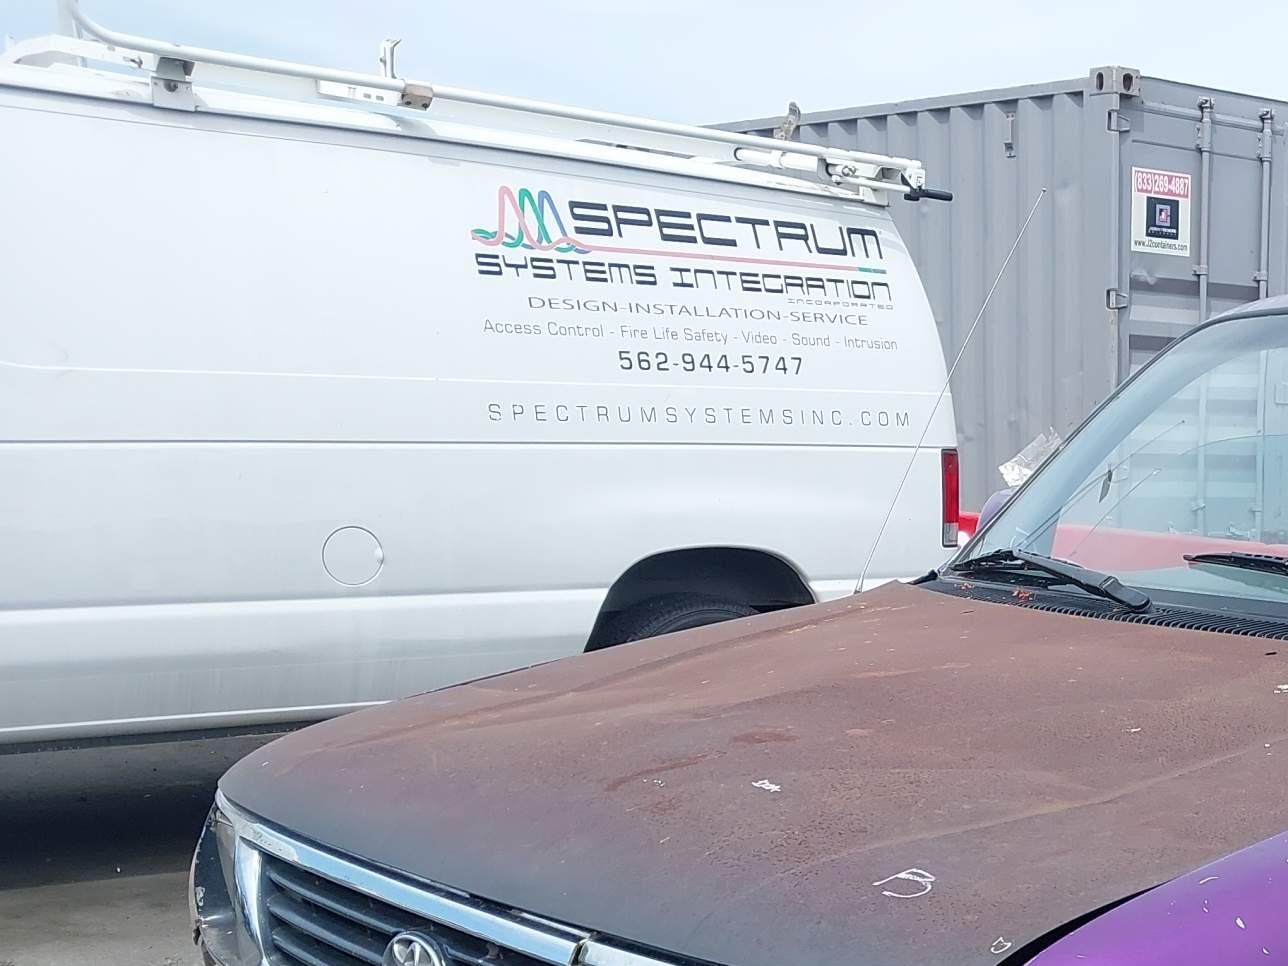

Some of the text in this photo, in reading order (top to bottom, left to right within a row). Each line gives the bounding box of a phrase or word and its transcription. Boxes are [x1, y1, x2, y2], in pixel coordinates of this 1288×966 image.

[1135, 171, 1189, 198] (833)269-4887
[568, 200, 884, 260] SPECTRUM
[475, 253, 892, 301] SYSTEMS INTEGRATION
[787, 298, 894, 310] INCORPORATED
[483, 319, 542, 335] Access
[547, 321, 604, 338] Control
[620, 324, 648, 340] Fire
[653, 326, 679, 341] Life
[684, 327, 728, 345] Safety
[741, 329, 778, 345] Video
[791, 332, 831, 347] Sound
[844, 335, 898, 351] Intrusion
[618, 350, 802, 375] 562-944-5747
[487, 403, 911, 427] SPECTRUMSYSTEMSINC.COM
